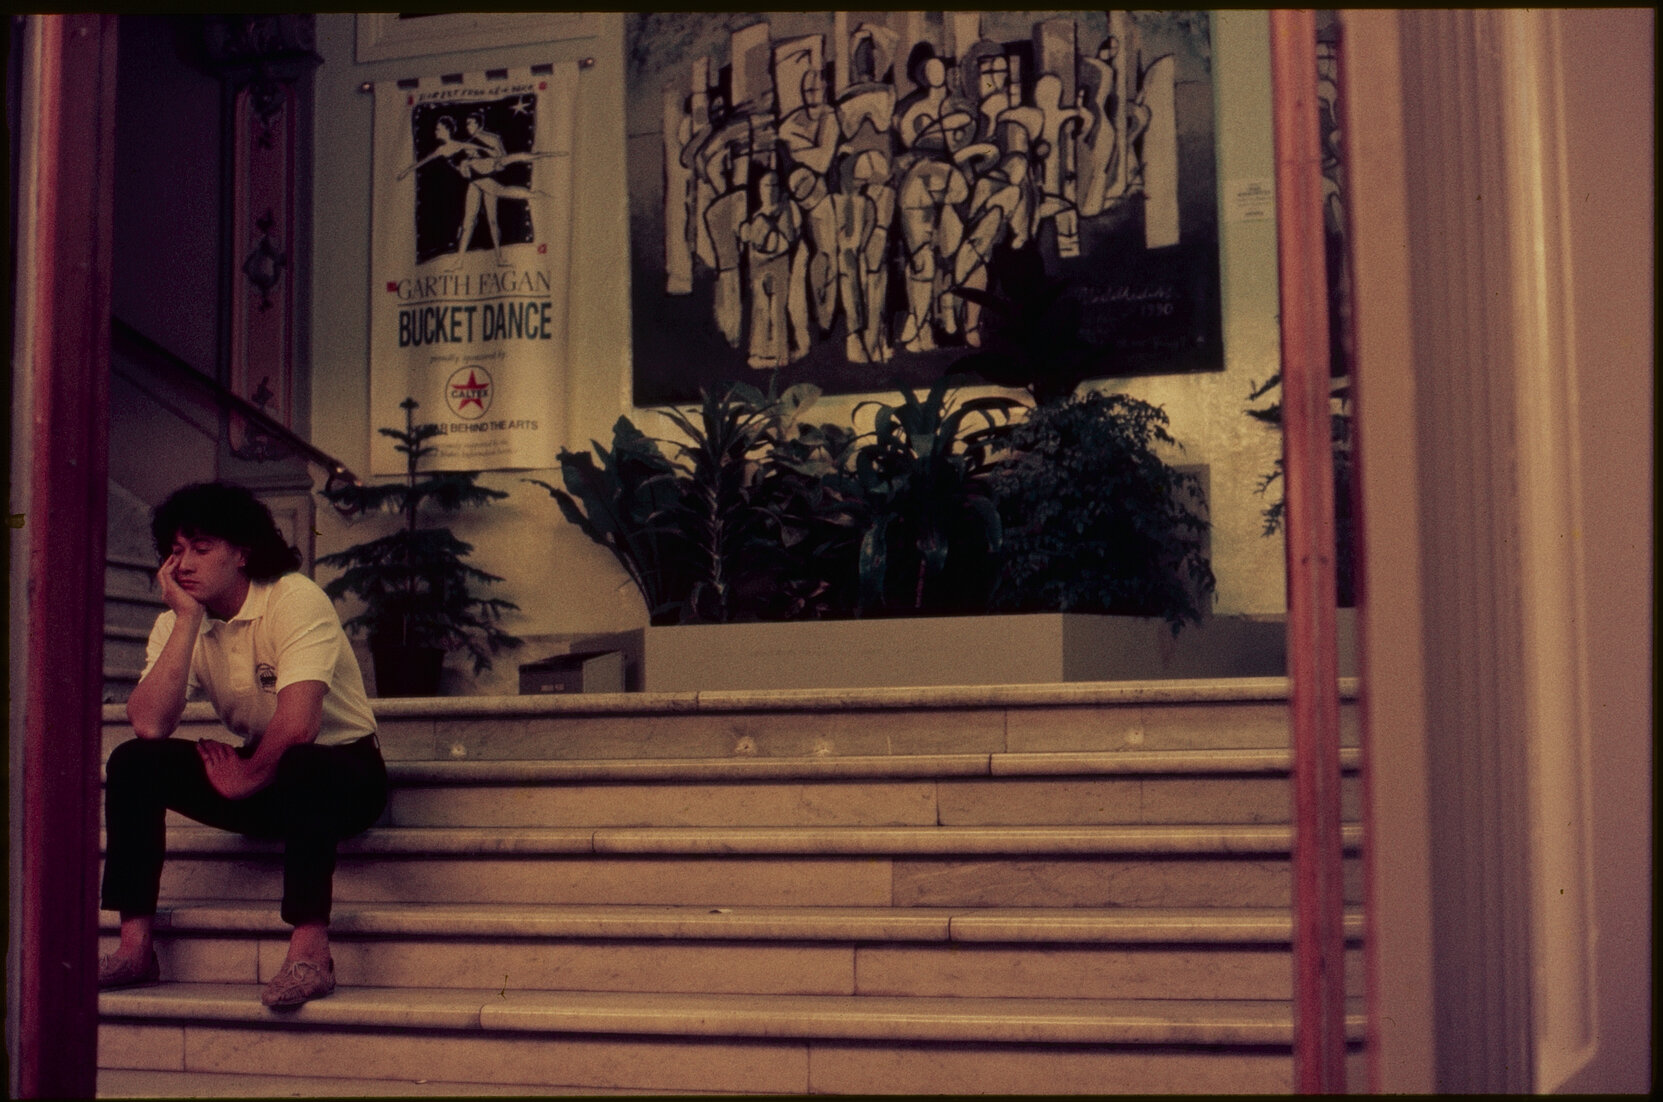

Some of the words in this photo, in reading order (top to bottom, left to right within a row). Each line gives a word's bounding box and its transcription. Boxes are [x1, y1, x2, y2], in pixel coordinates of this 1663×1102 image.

[462, 87, 485, 97] FROM
[397, 274, 469, 300] GARTH
[479, 271, 550, 295] FAGAN
[399, 306, 477, 346] BUCKET
[483, 302, 552, 341] DANCE
[451, 390, 489, 399] CALTEX
[450, 422, 488, 433] BEHIND
[489, 421, 508, 431] THE
[509, 420, 538, 431] ARTS
